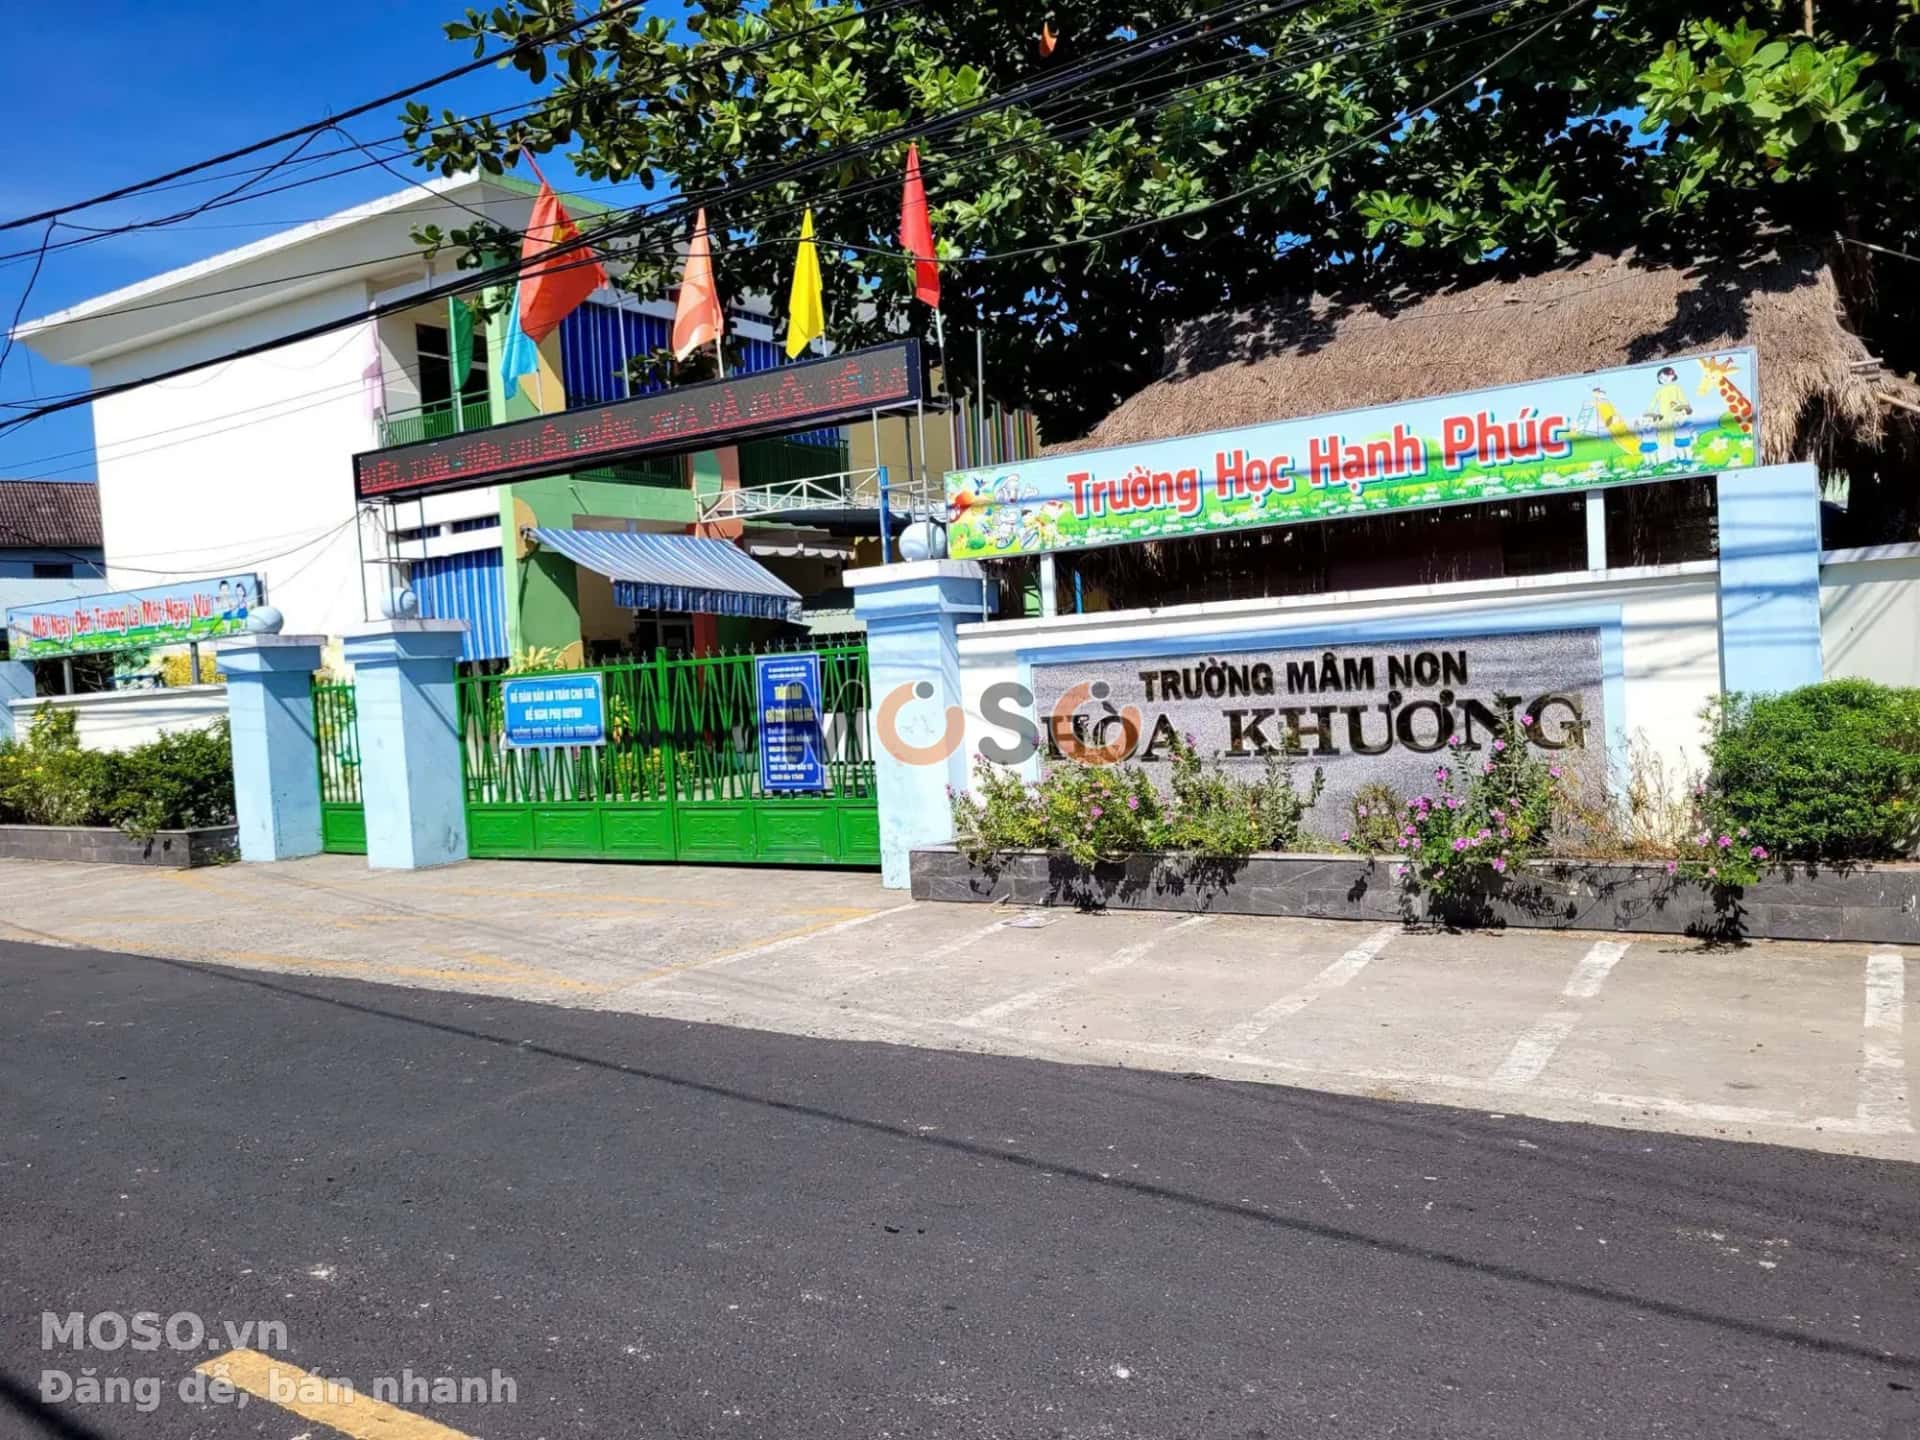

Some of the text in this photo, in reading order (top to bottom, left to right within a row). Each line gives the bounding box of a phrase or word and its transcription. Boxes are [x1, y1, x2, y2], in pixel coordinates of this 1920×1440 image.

[1067, 407, 1566, 514] Trường Học Hạnh Phúc
[1139, 657, 1275, 702] TRƯỜNG
[1387, 650, 1468, 689] NON
[1041, 689, 1591, 763] HÒA KHƯƠNG
